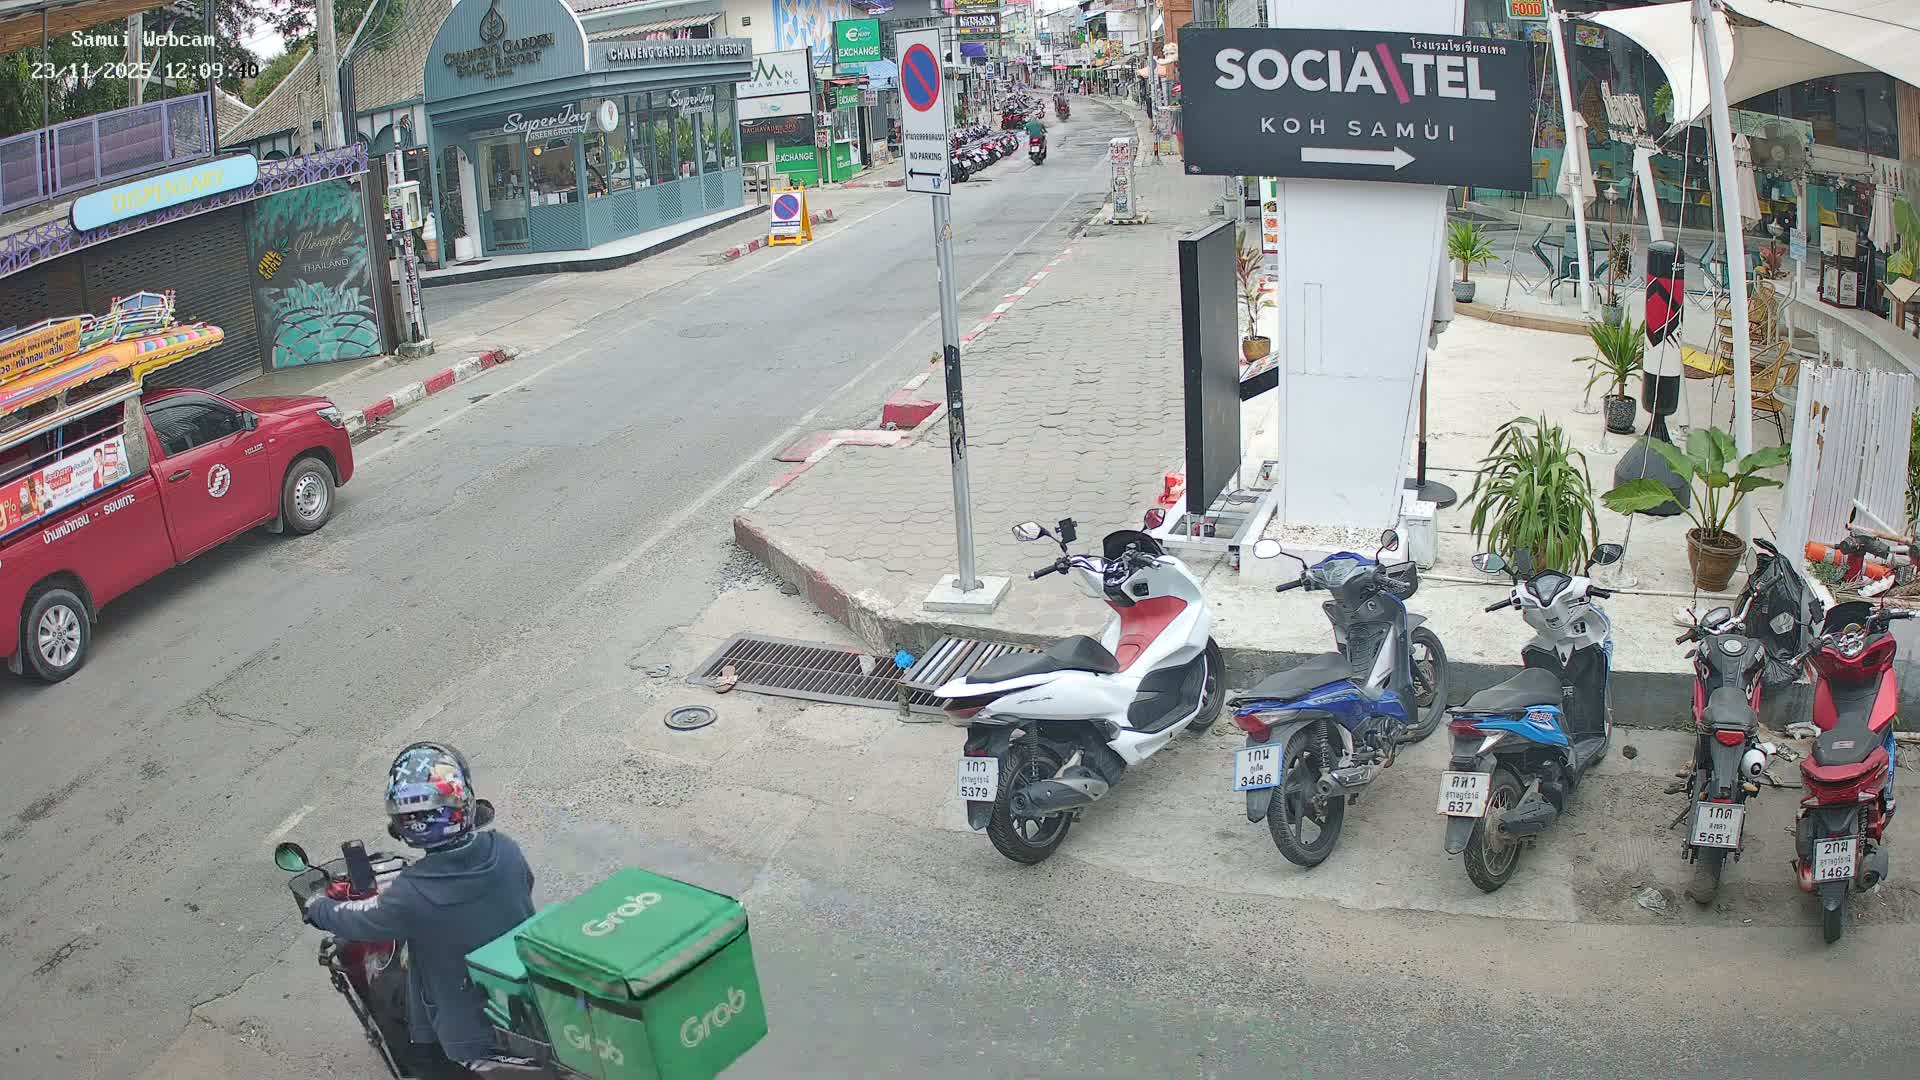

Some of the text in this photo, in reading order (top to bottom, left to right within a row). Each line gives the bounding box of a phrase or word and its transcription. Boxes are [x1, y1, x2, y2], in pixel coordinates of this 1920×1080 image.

[1512, 3, 1542, 16] FOOD
[502, 33, 554, 52] GARDEN
[1410, 37, 1507, 55] โรงแรมโซเชียลเทล
[610, 43, 746, 60] CHAWENG GARDEN BEACH RESORT
[839, 46, 879, 57] EXCHANGE
[503, 103, 592, 142] SuperJay
[1260, 117, 1455, 142] KOH SAMUI
[776, 152, 814, 163] EXCHANGE
[910, 152, 942, 161] NO PARKING
[112, 167, 226, 215] DISPENSARY
[296, 222, 353, 258] Pineapple
[303, 258, 350, 273] THAILAND
[42, 512, 90, 545] บ้านหน้าทอน
[966, 761, 987, 773] 1กว
[961, 786, 988, 798] 5379
[1447, 801, 1473, 813] 637
[1698, 832, 1731, 844] 5651
[1820, 865, 1851, 879] 1462
[580, 890, 663, 938] Grab
[678, 985, 746, 1050] Grab
[563, 1024, 624, 1065] Grab
